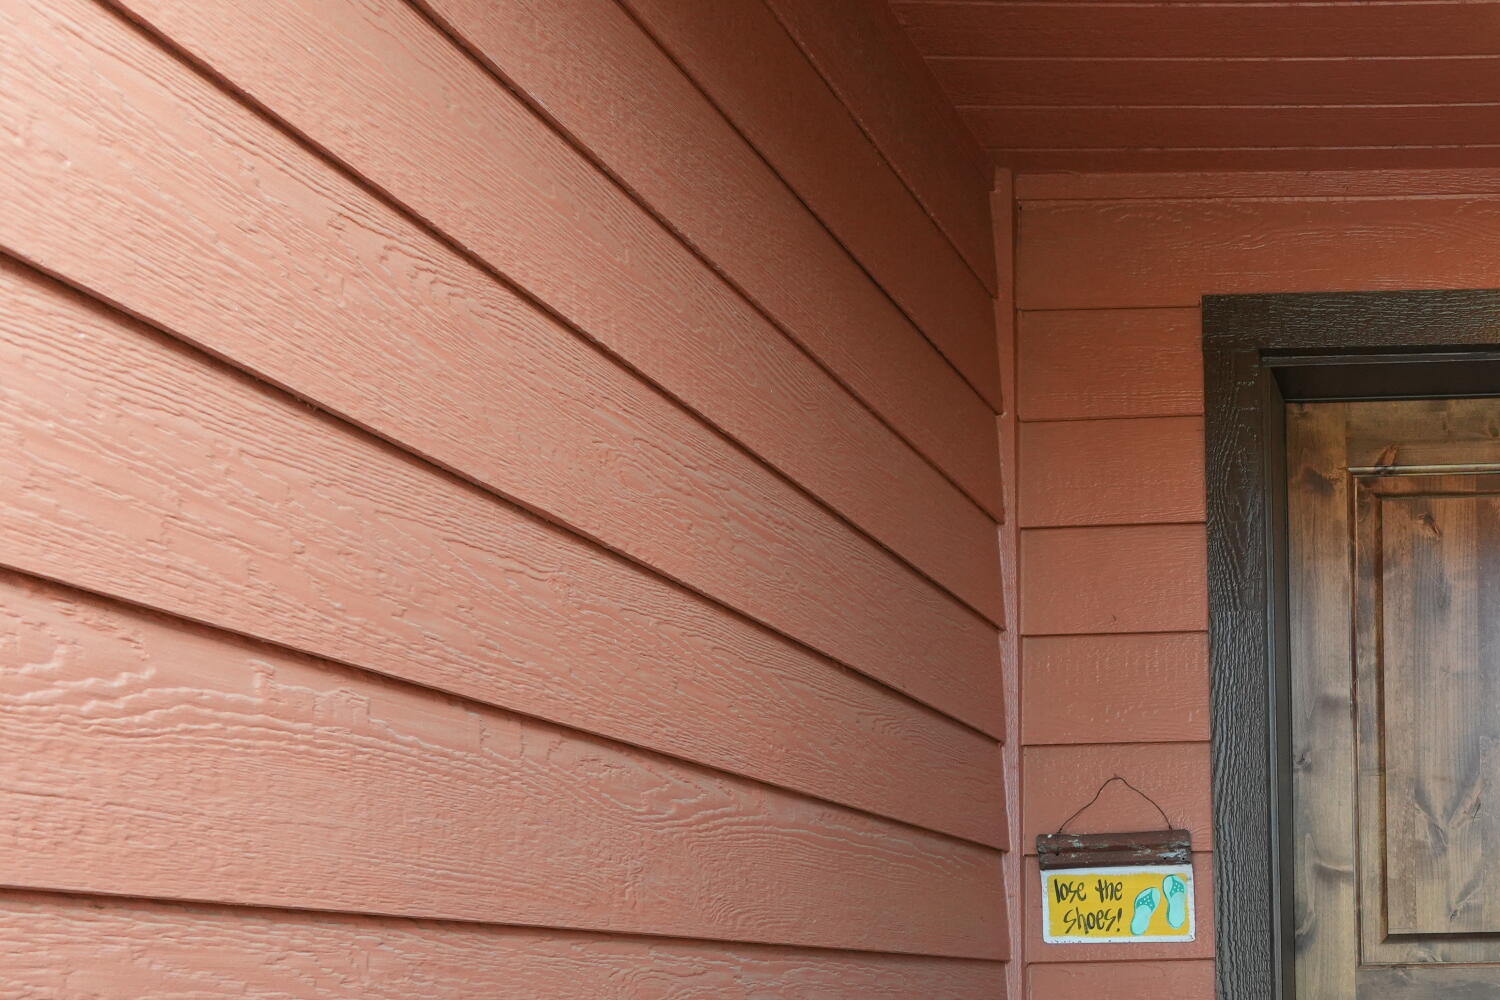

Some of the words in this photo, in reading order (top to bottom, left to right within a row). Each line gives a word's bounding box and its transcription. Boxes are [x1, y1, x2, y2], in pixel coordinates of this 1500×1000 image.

[1054, 878, 1086, 904] lose
[1095, 878, 1123, 903] the
[1063, 907, 1123, 934] shoes!
